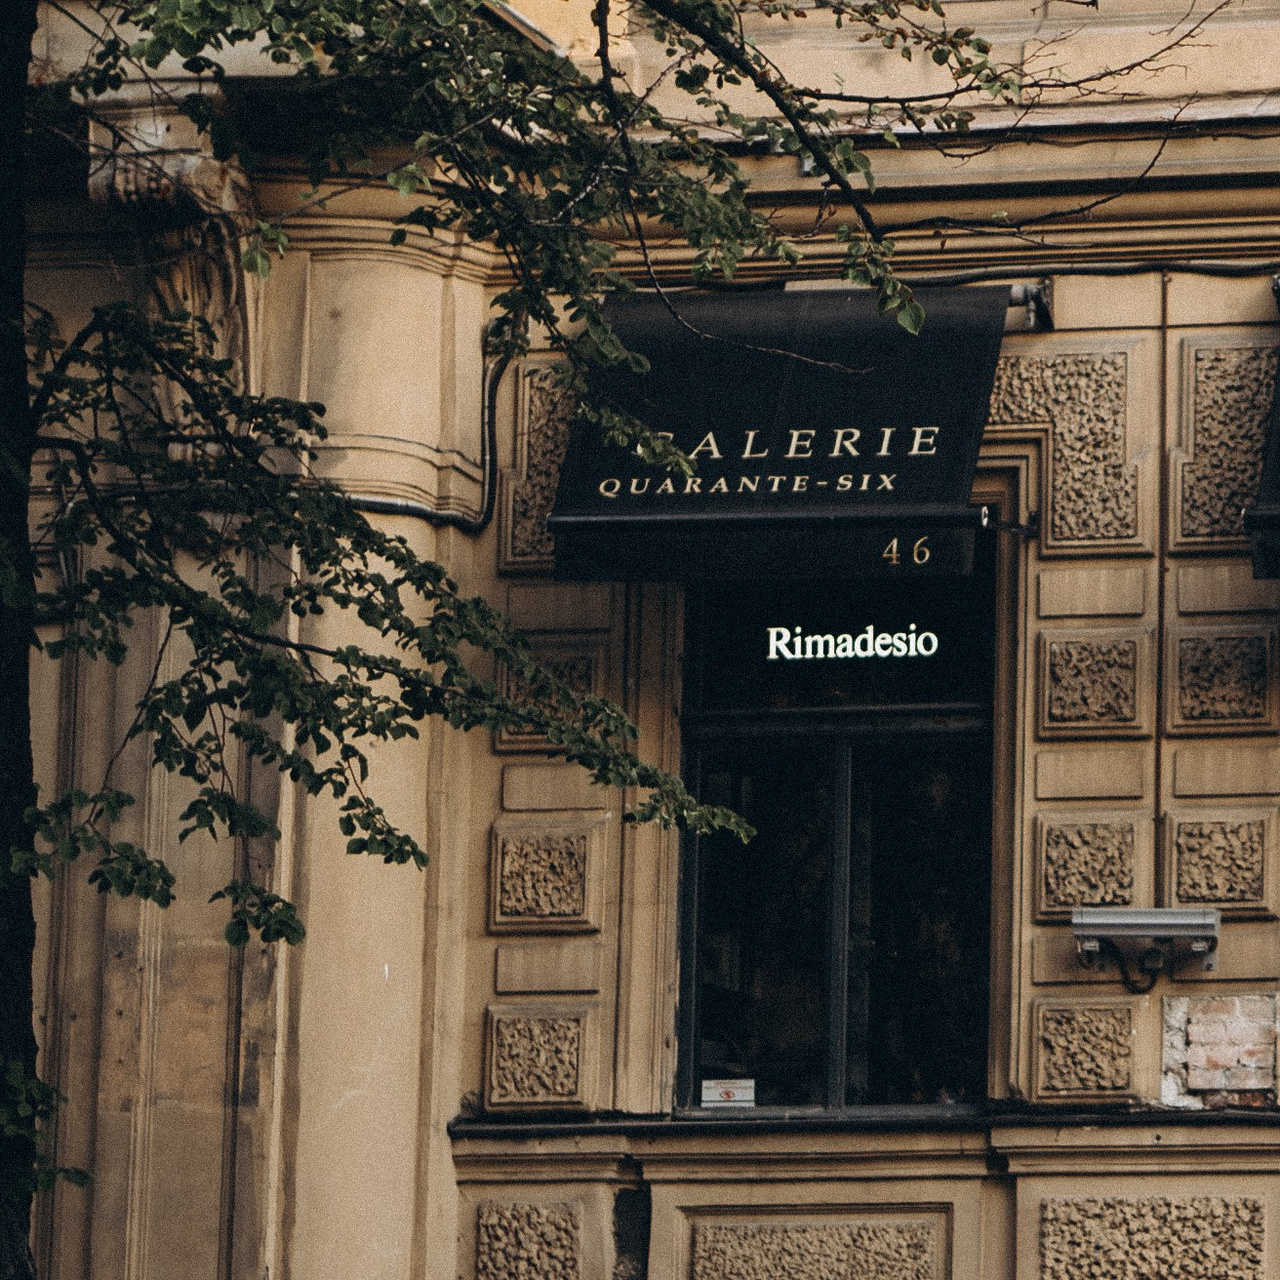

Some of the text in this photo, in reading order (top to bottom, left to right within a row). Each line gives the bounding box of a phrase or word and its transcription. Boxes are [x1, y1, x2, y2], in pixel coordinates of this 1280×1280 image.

[598, 472, 897, 498] QUARANTE-SIX
[881, 535, 931, 565] 46
[766, 623, 939, 661] Rimadesio
